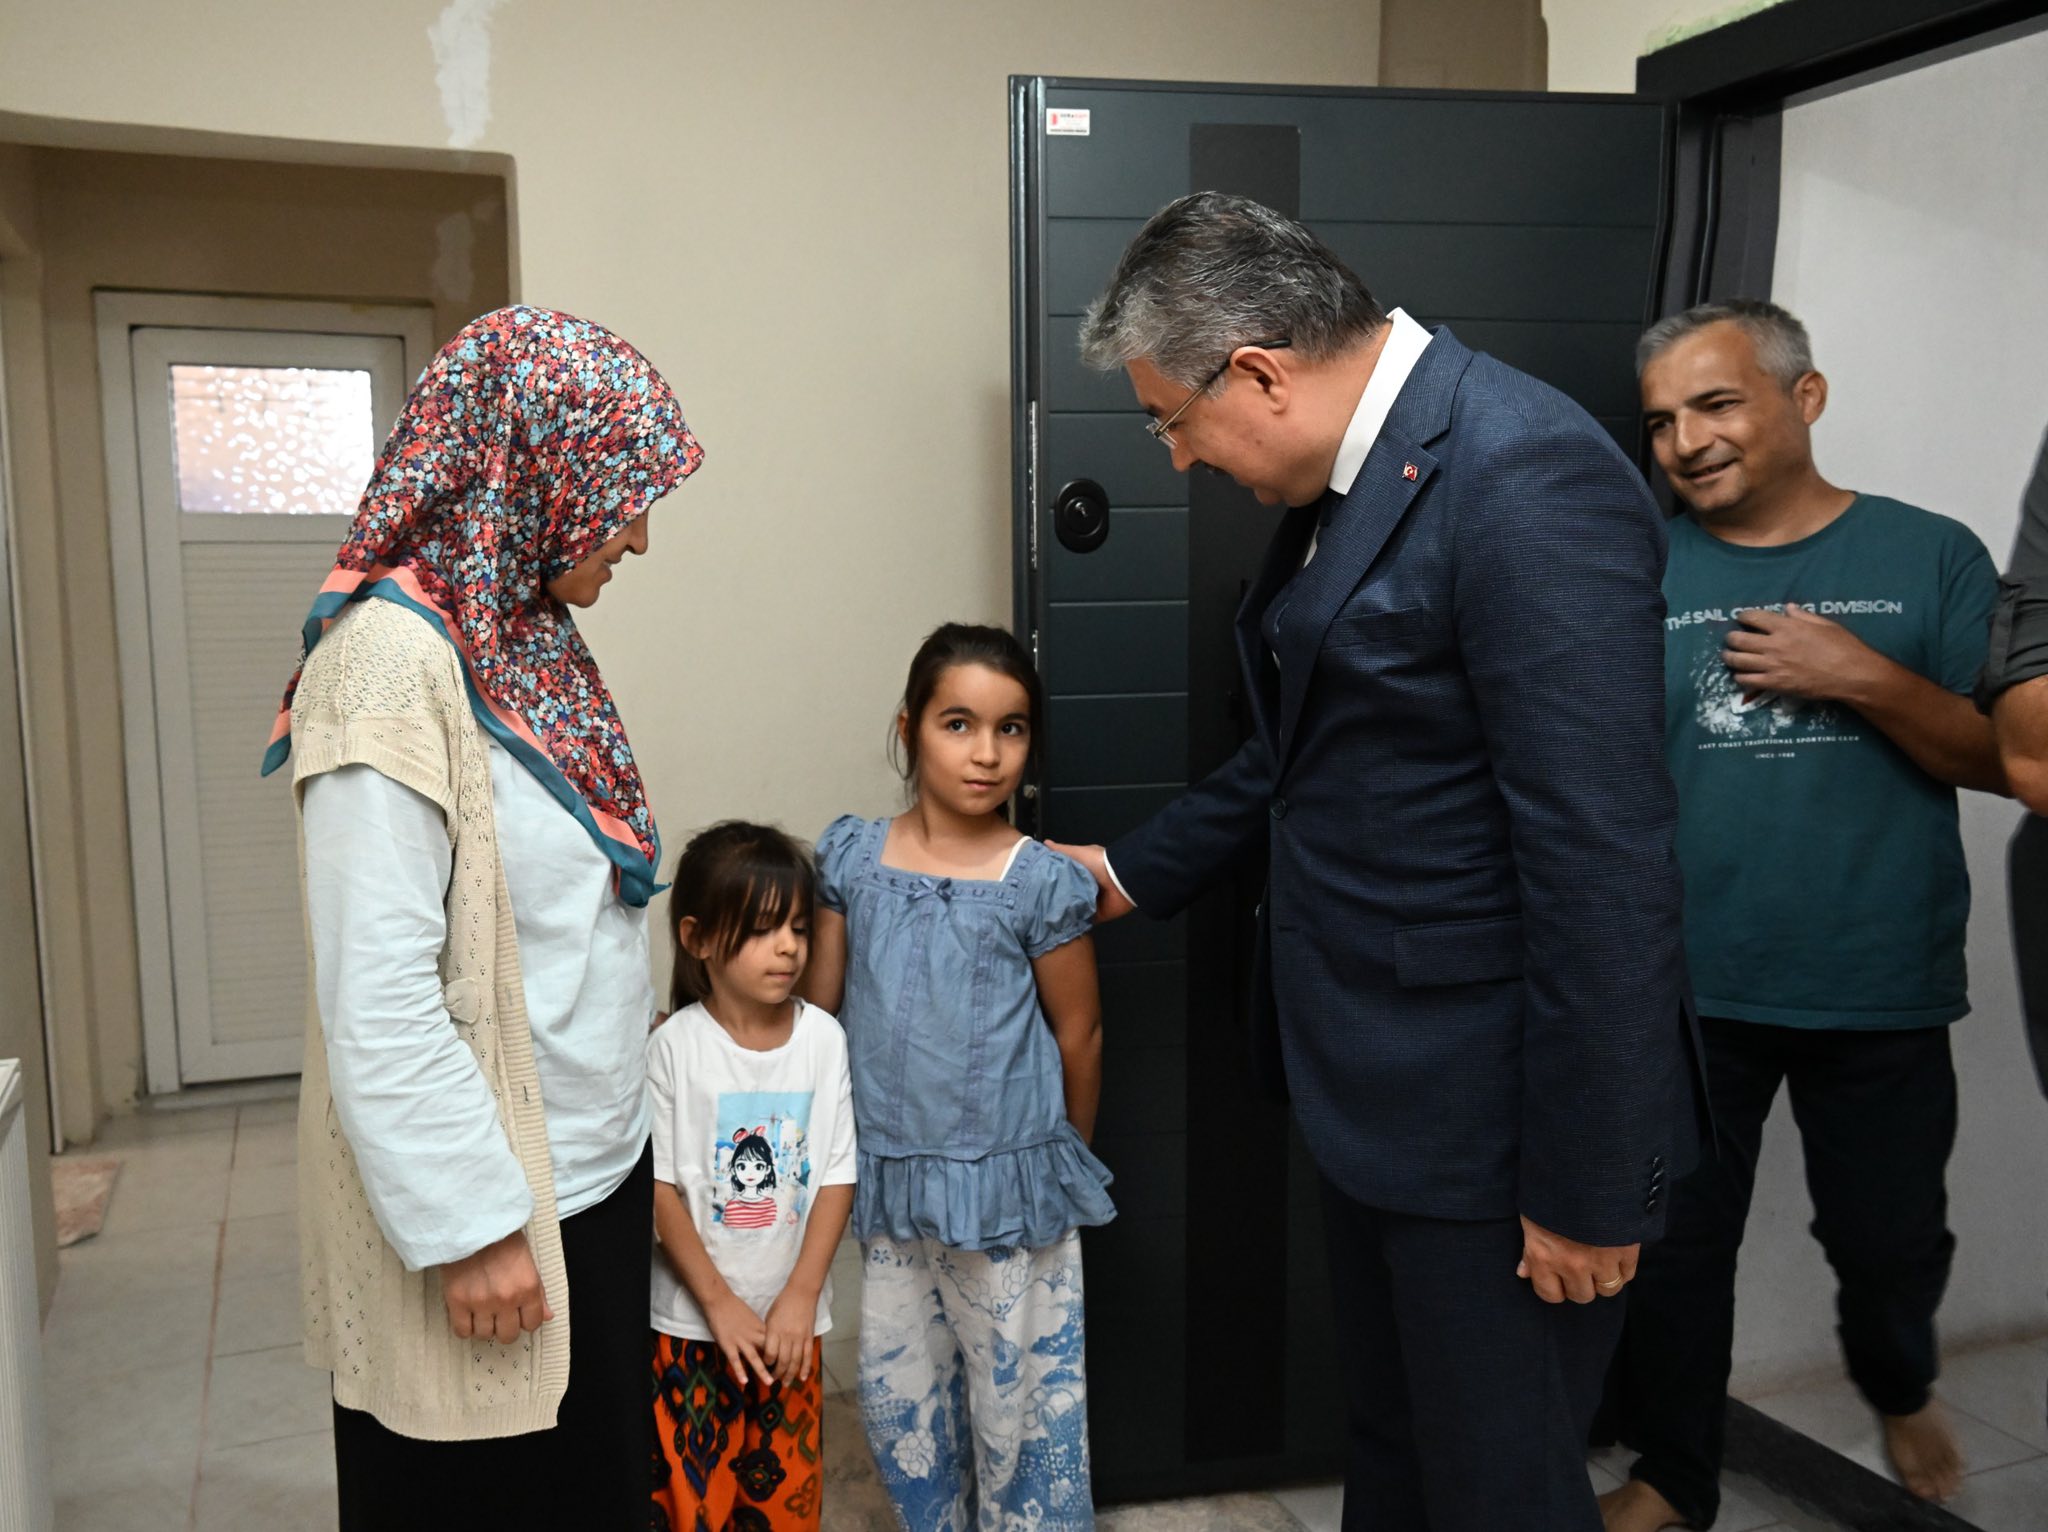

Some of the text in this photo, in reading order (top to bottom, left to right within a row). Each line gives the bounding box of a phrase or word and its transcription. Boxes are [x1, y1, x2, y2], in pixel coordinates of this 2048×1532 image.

[1665, 611, 1692, 631] THE
[1693, 608, 1729, 624] SAIL
[1820, 599, 1903, 615] DIVISION
